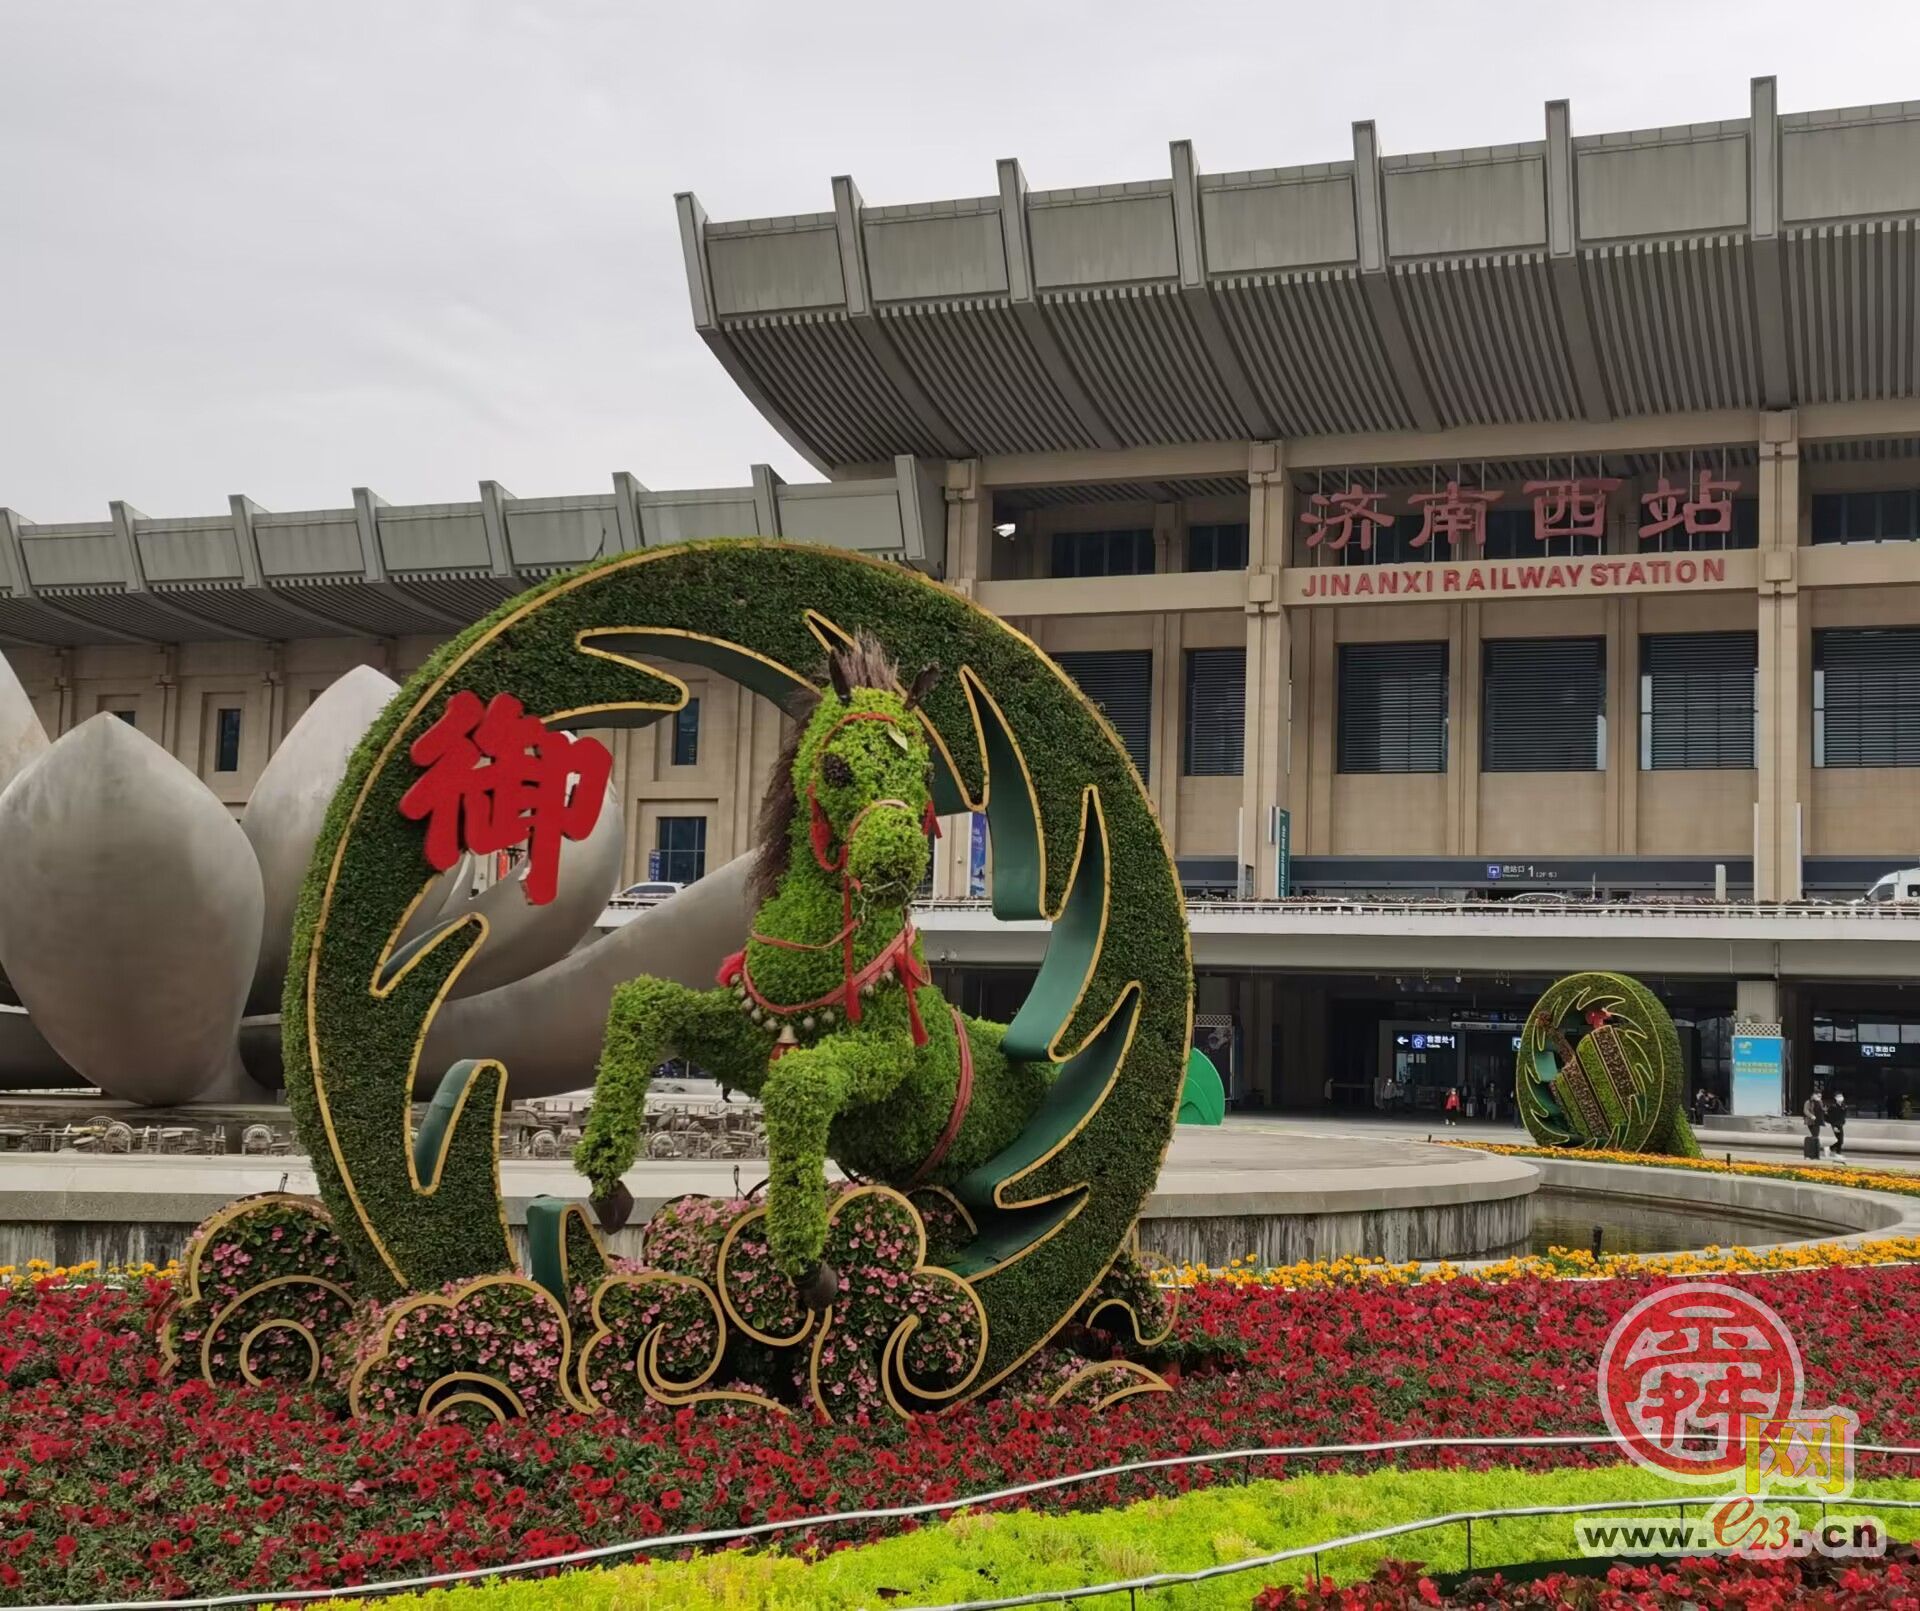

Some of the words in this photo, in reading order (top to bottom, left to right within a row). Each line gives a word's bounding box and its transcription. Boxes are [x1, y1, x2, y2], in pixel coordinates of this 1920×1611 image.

[1301, 471, 1741, 550] 济南西站
[1301, 570, 1433, 597] JINANXI
[1443, 564, 1584, 592] RAILWAY
[1590, 558, 1725, 587] STATION
[399, 690, 613, 905] 御
